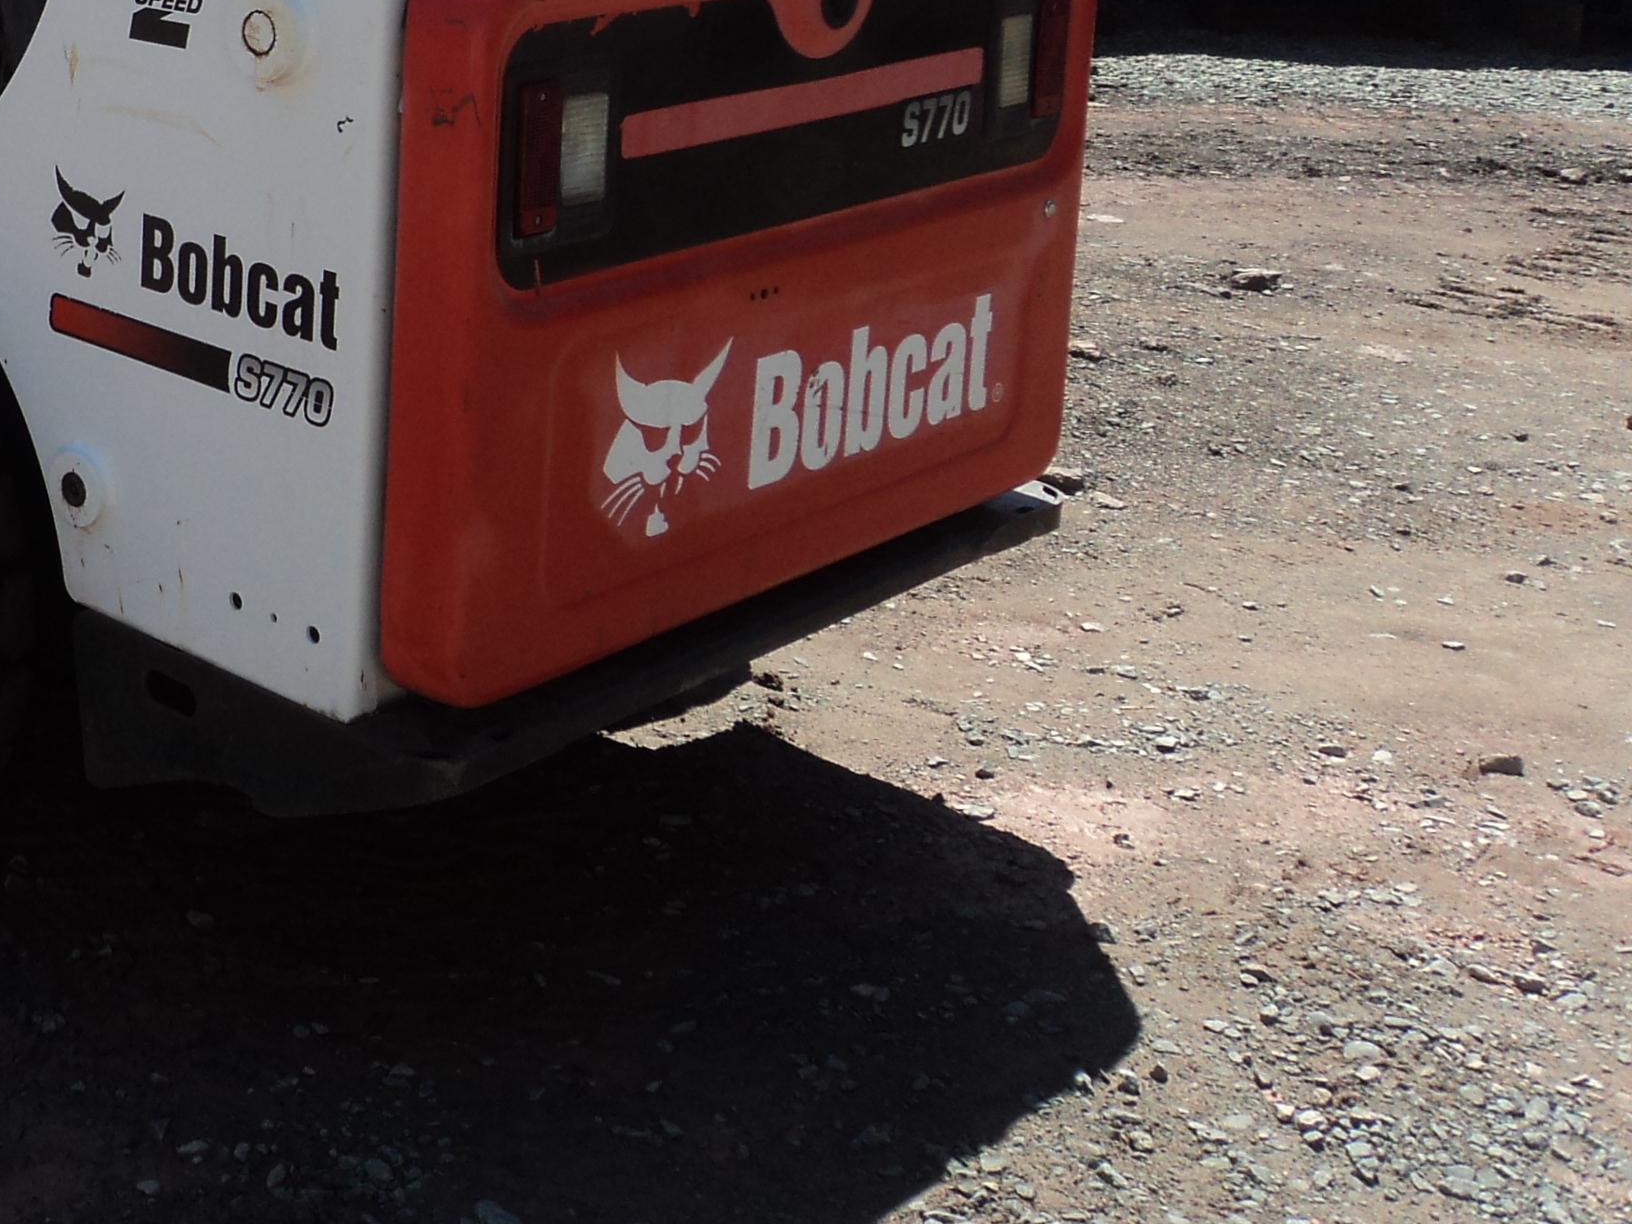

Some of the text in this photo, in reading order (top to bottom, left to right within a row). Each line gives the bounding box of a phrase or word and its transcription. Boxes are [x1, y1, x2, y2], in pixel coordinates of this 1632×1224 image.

[901, 90, 971, 147] S770
[140, 212, 340, 351] Bobcat
[234, 352, 334, 427] S770
[747, 293, 993, 490] Bobcat
